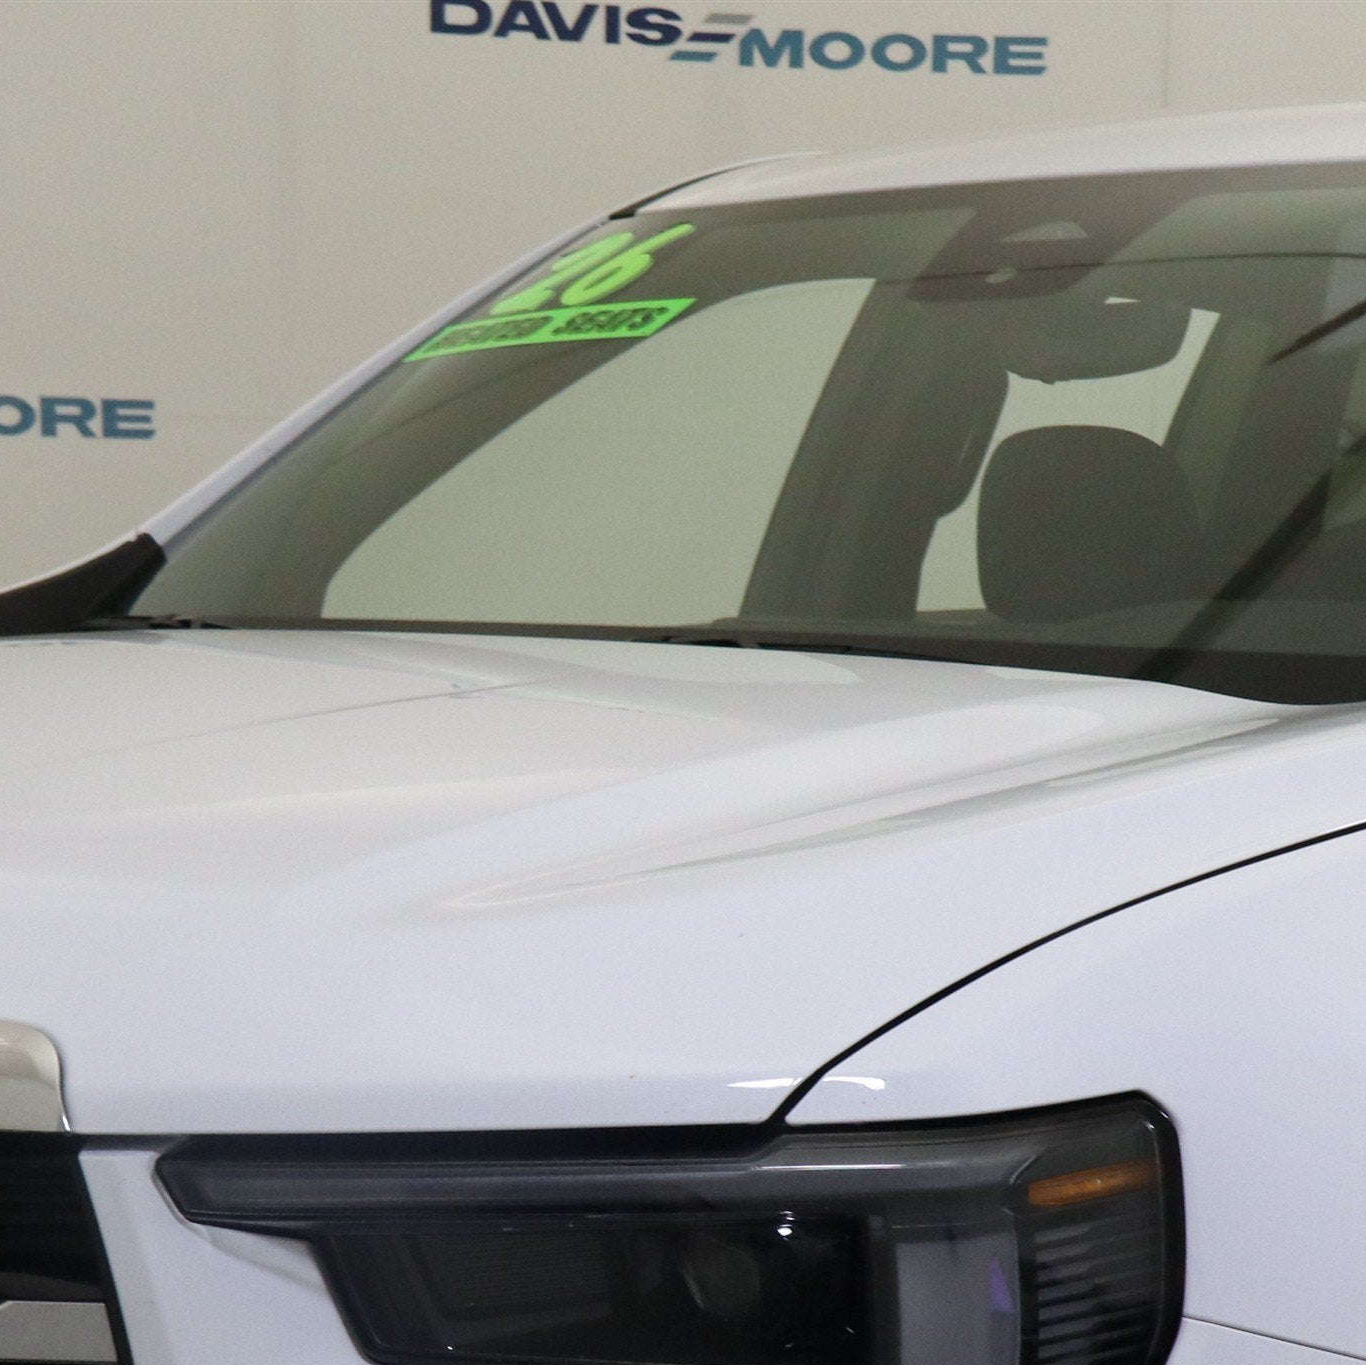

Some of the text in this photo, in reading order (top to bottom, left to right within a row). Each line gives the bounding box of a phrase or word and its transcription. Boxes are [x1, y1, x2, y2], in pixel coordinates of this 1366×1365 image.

[430, 0, 1049, 76] DAVIS MOORE
[489, 222, 696, 315] 26
